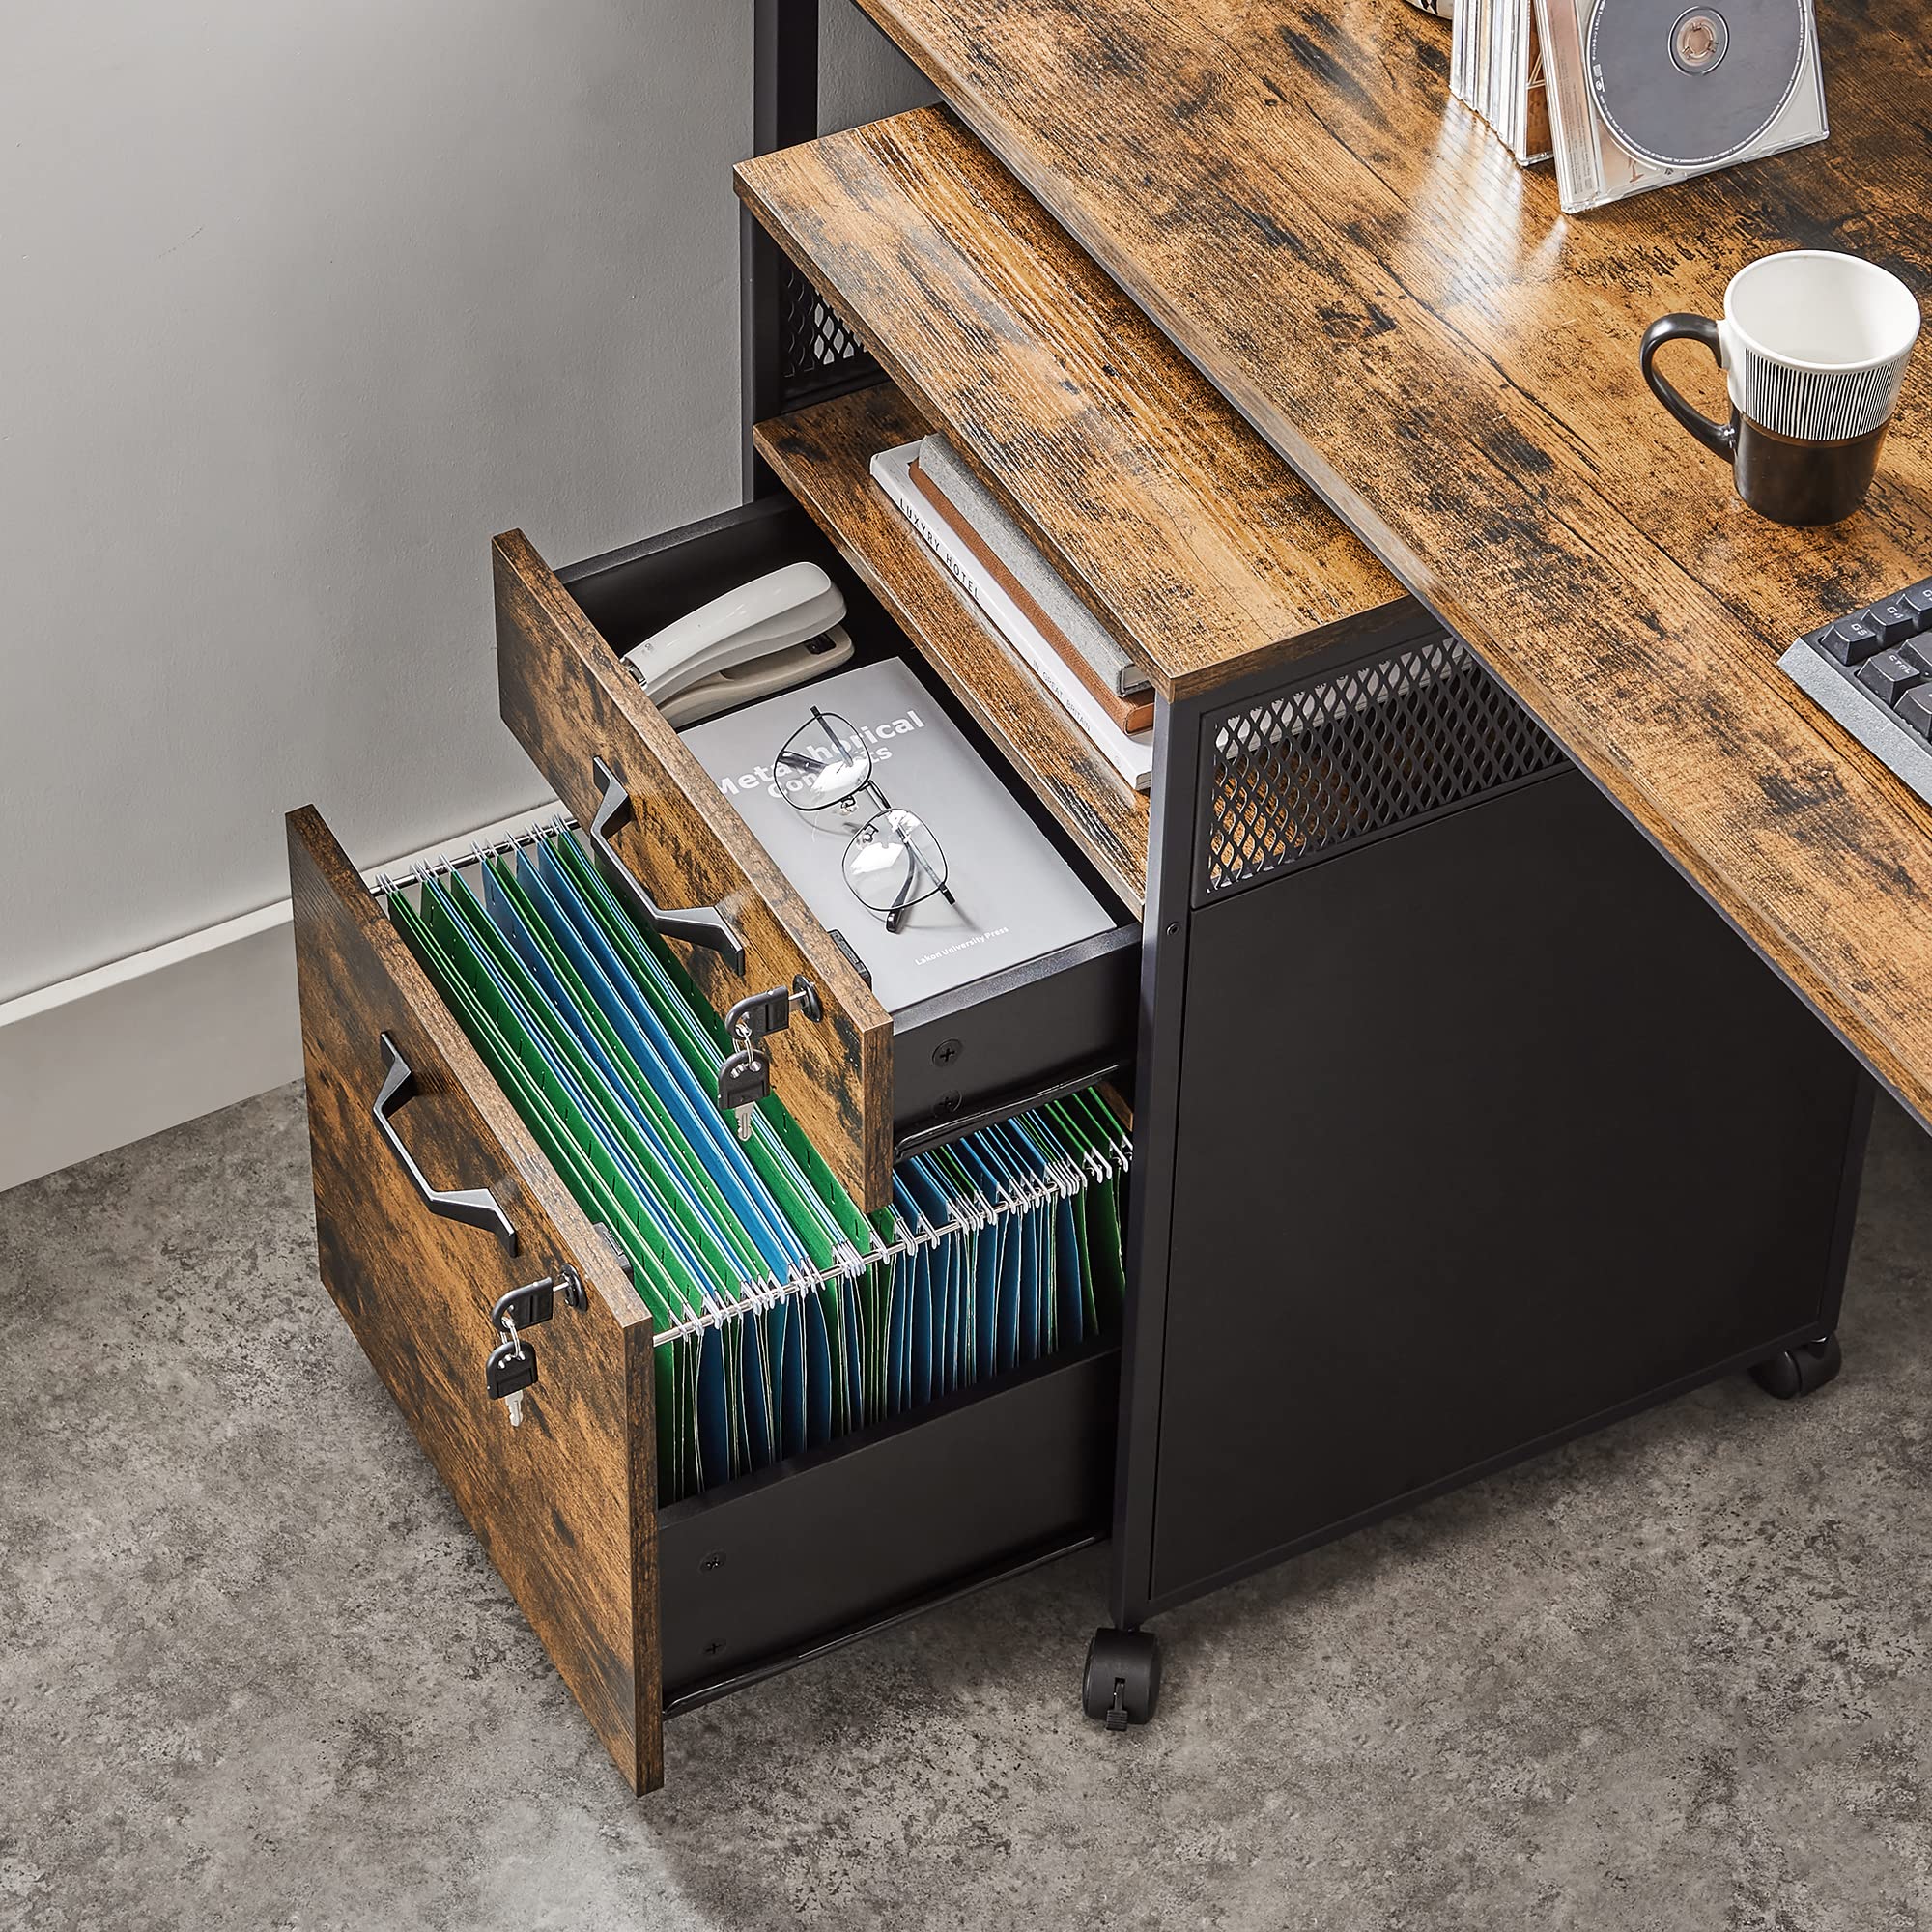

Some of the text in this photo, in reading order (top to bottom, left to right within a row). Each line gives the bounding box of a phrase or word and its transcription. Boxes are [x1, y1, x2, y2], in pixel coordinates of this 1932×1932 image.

[946, 554, 980, 601] HOTEL
[1851, 623, 1869, 636] G5
[1889, 655, 1912, 674] CTRL
[1066, 699, 1091, 732] BRITAIN
[718, 709, 925, 796] Metahorical
[914, 926, 1009, 966] Lakon University Press
